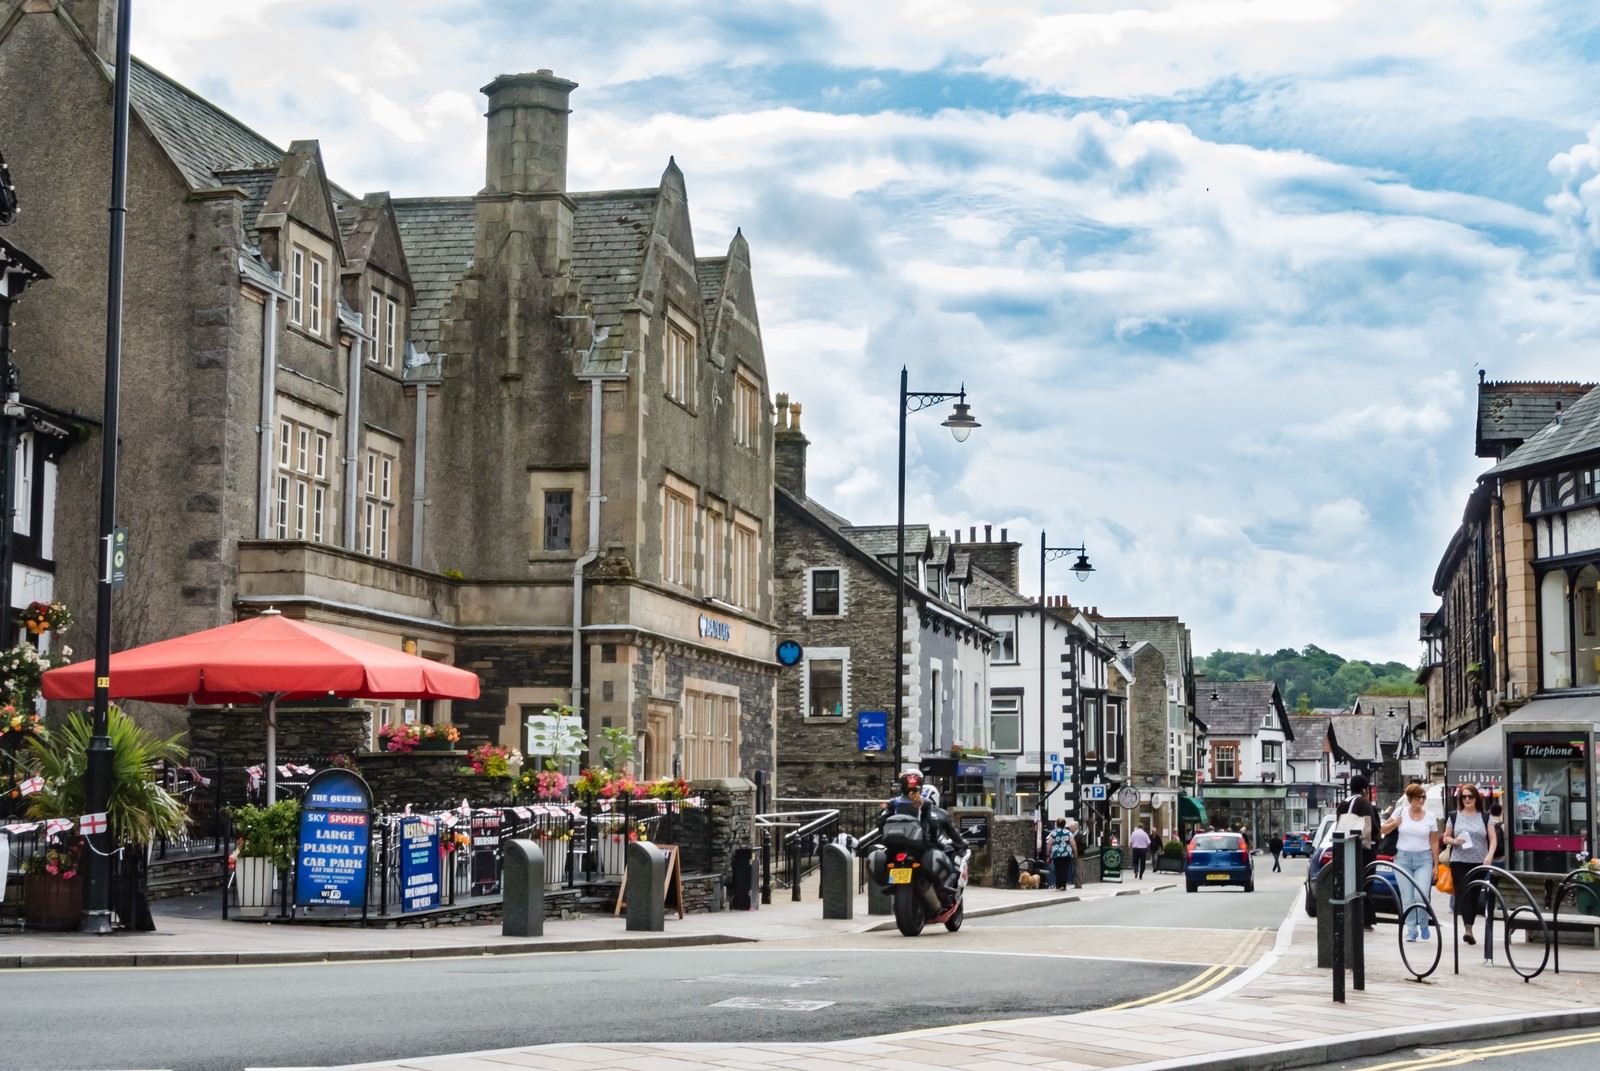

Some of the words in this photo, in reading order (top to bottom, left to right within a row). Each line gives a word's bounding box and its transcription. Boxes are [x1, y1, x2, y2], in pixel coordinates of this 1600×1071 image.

[1524, 745, 1573, 757] Telephone
[1094, 787, 1102, 798] P
[312, 794, 328, 802] THE
[330, 795, 362, 803] QUEENS
[308, 813, 325, 822] SKY
[329, 814, 365, 824] SPORTS
[316, 830, 355, 840] LARGE
[473, 836, 499, 846] THURSDAY
[303, 843, 349, 854] PLASMA
[352, 845, 367, 854] TV
[303, 857, 326, 867] CAR
[329, 858, 363, 869] PARK
